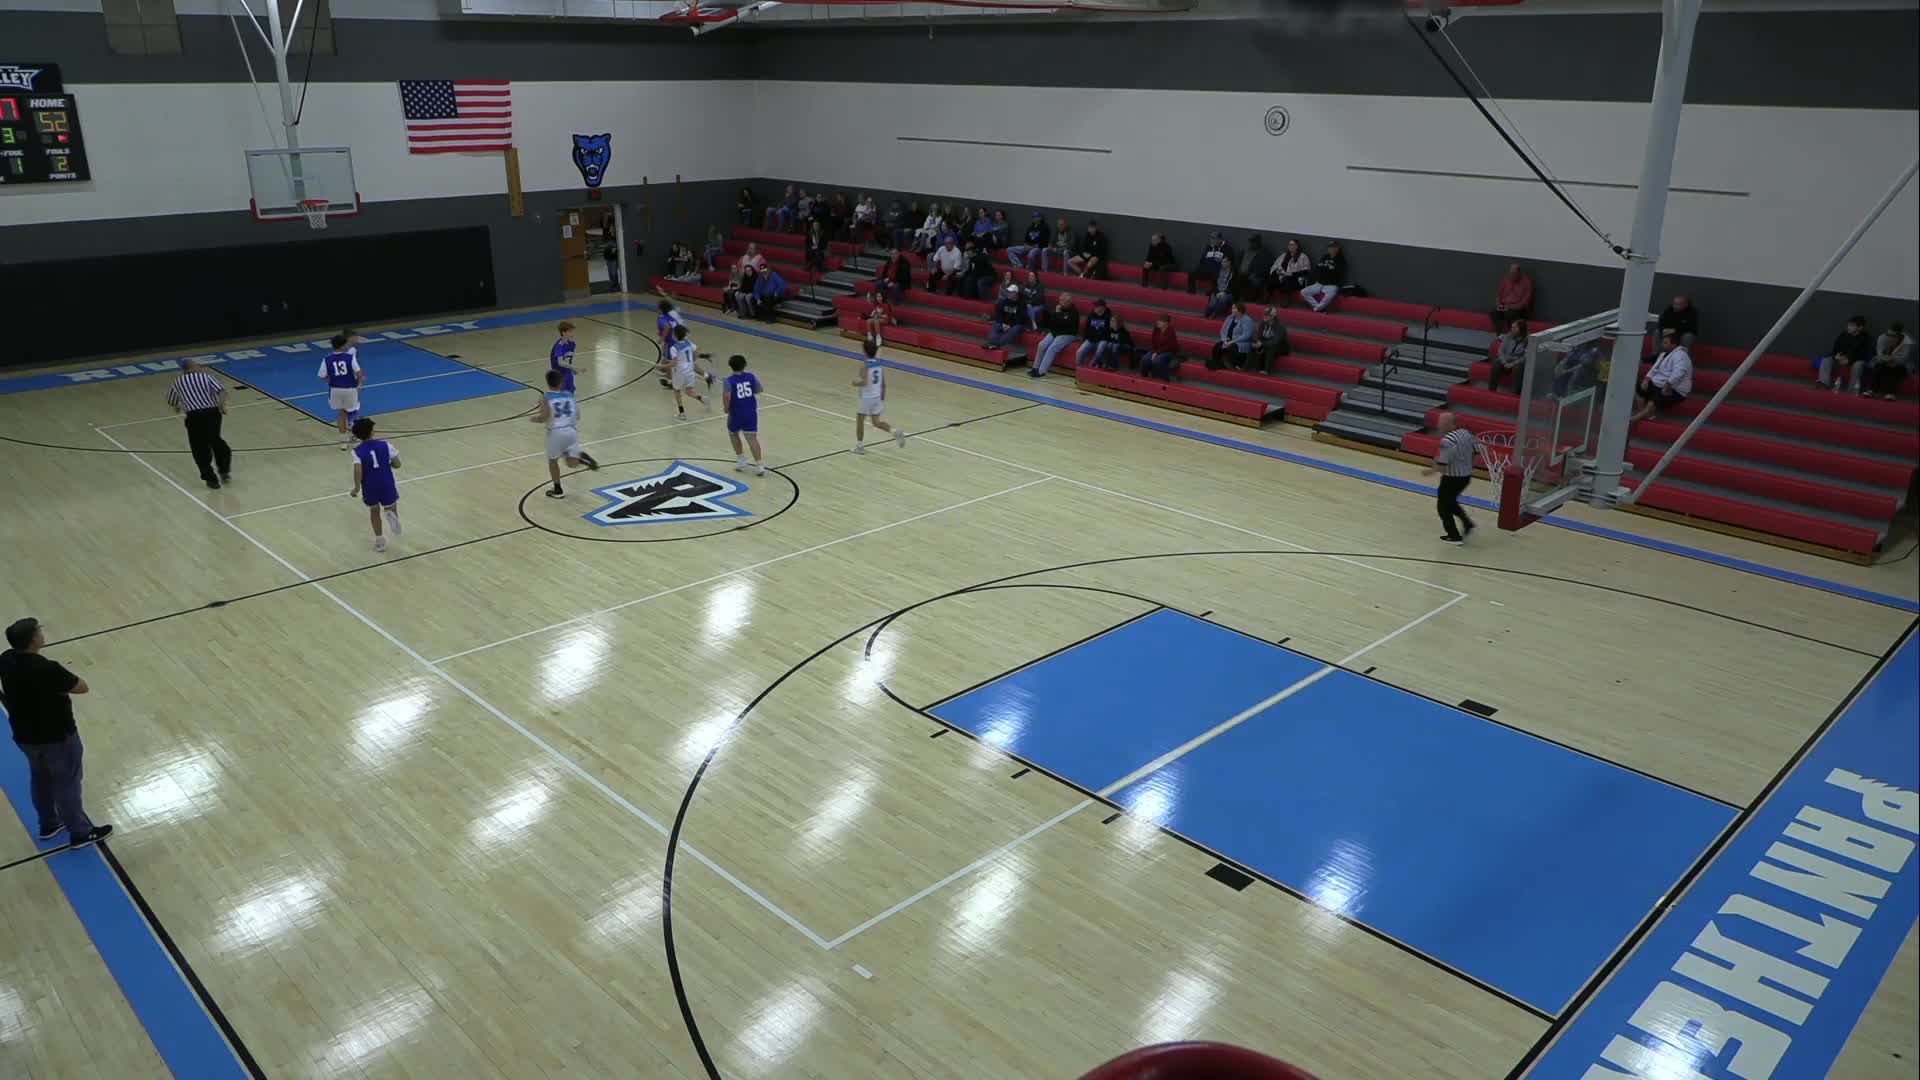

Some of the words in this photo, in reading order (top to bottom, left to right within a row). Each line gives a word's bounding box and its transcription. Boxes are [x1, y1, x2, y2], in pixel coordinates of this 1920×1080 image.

[0, 72, 29, 84] LEY
[30, 99, 64, 108] HOME
[40, 111, 68, 132] 52
[57, 350, 267, 382] RIVER
[333, 360, 348, 376] 13
[736, 382, 753, 399] 25
[369, 450, 380, 469] 1
